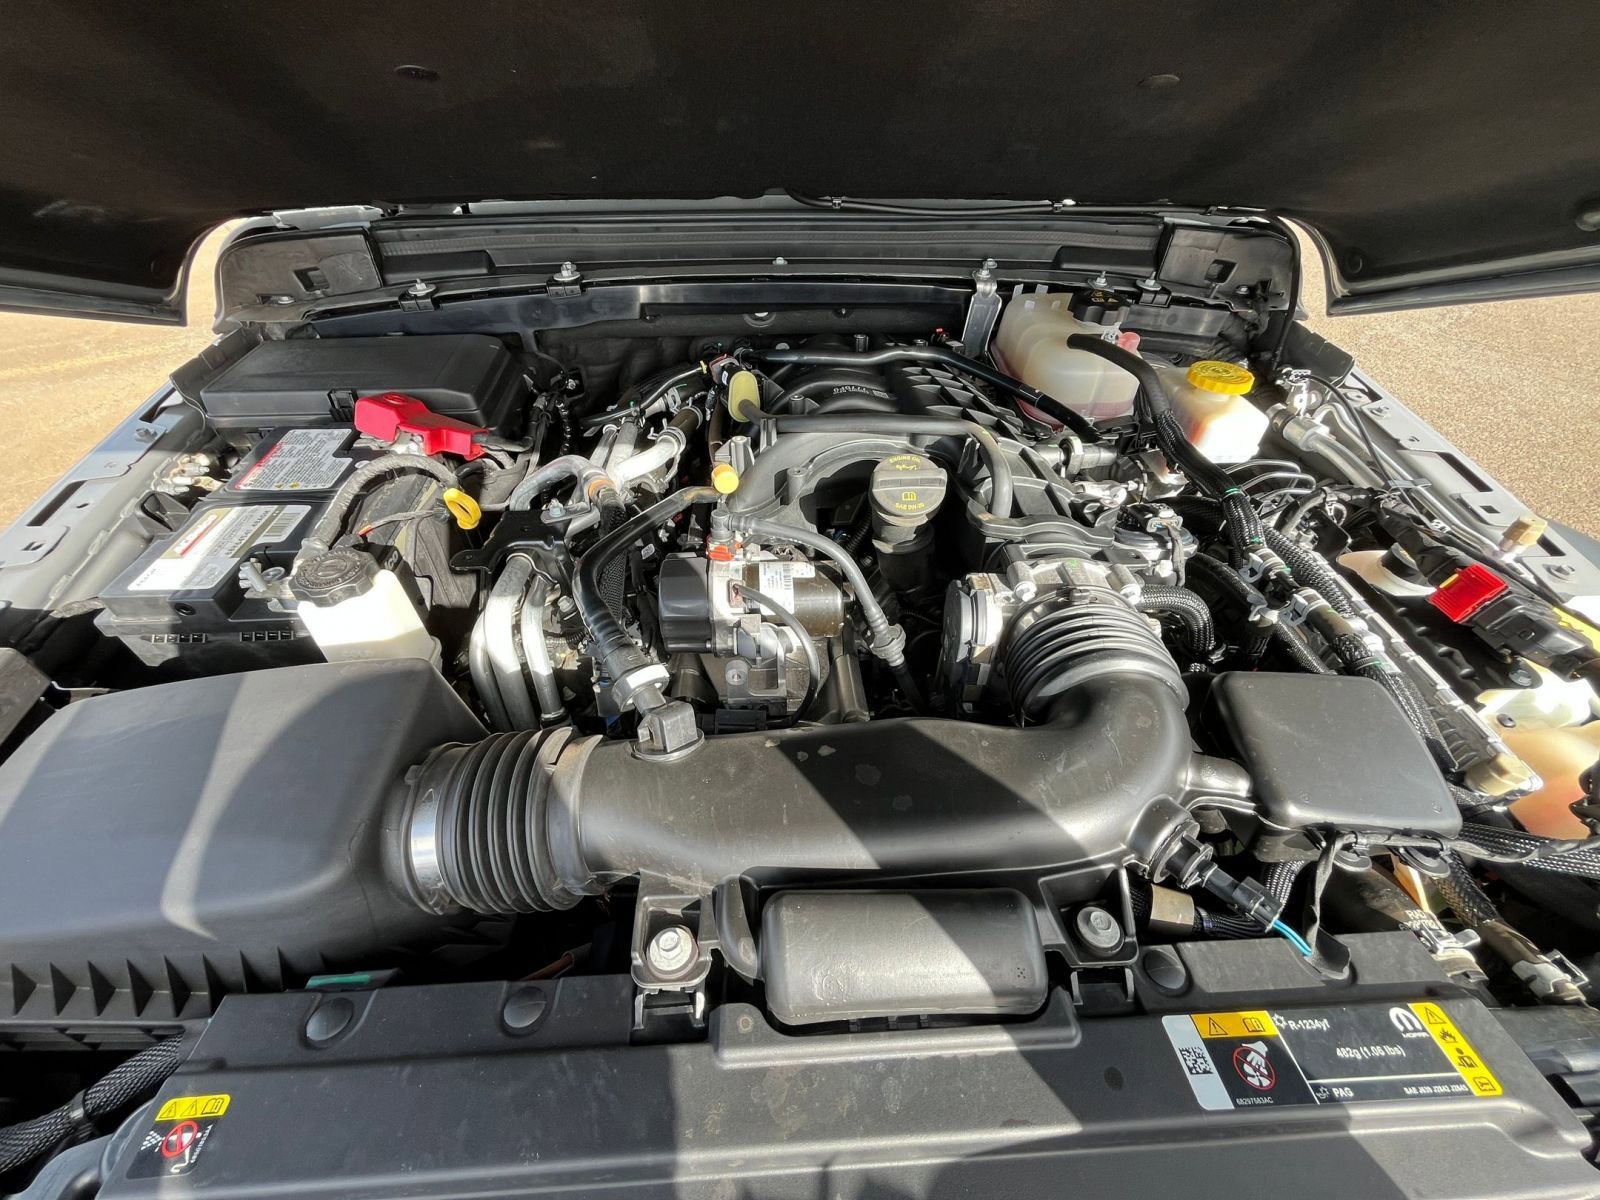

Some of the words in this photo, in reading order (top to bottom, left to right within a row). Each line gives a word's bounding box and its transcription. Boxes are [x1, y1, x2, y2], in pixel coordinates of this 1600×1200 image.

[1287, 1018, 1331, 1031] R-1234yf
[1383, 1044, 1406, 1057] lbs)
[1331, 1086, 1355, 1098] PAG
